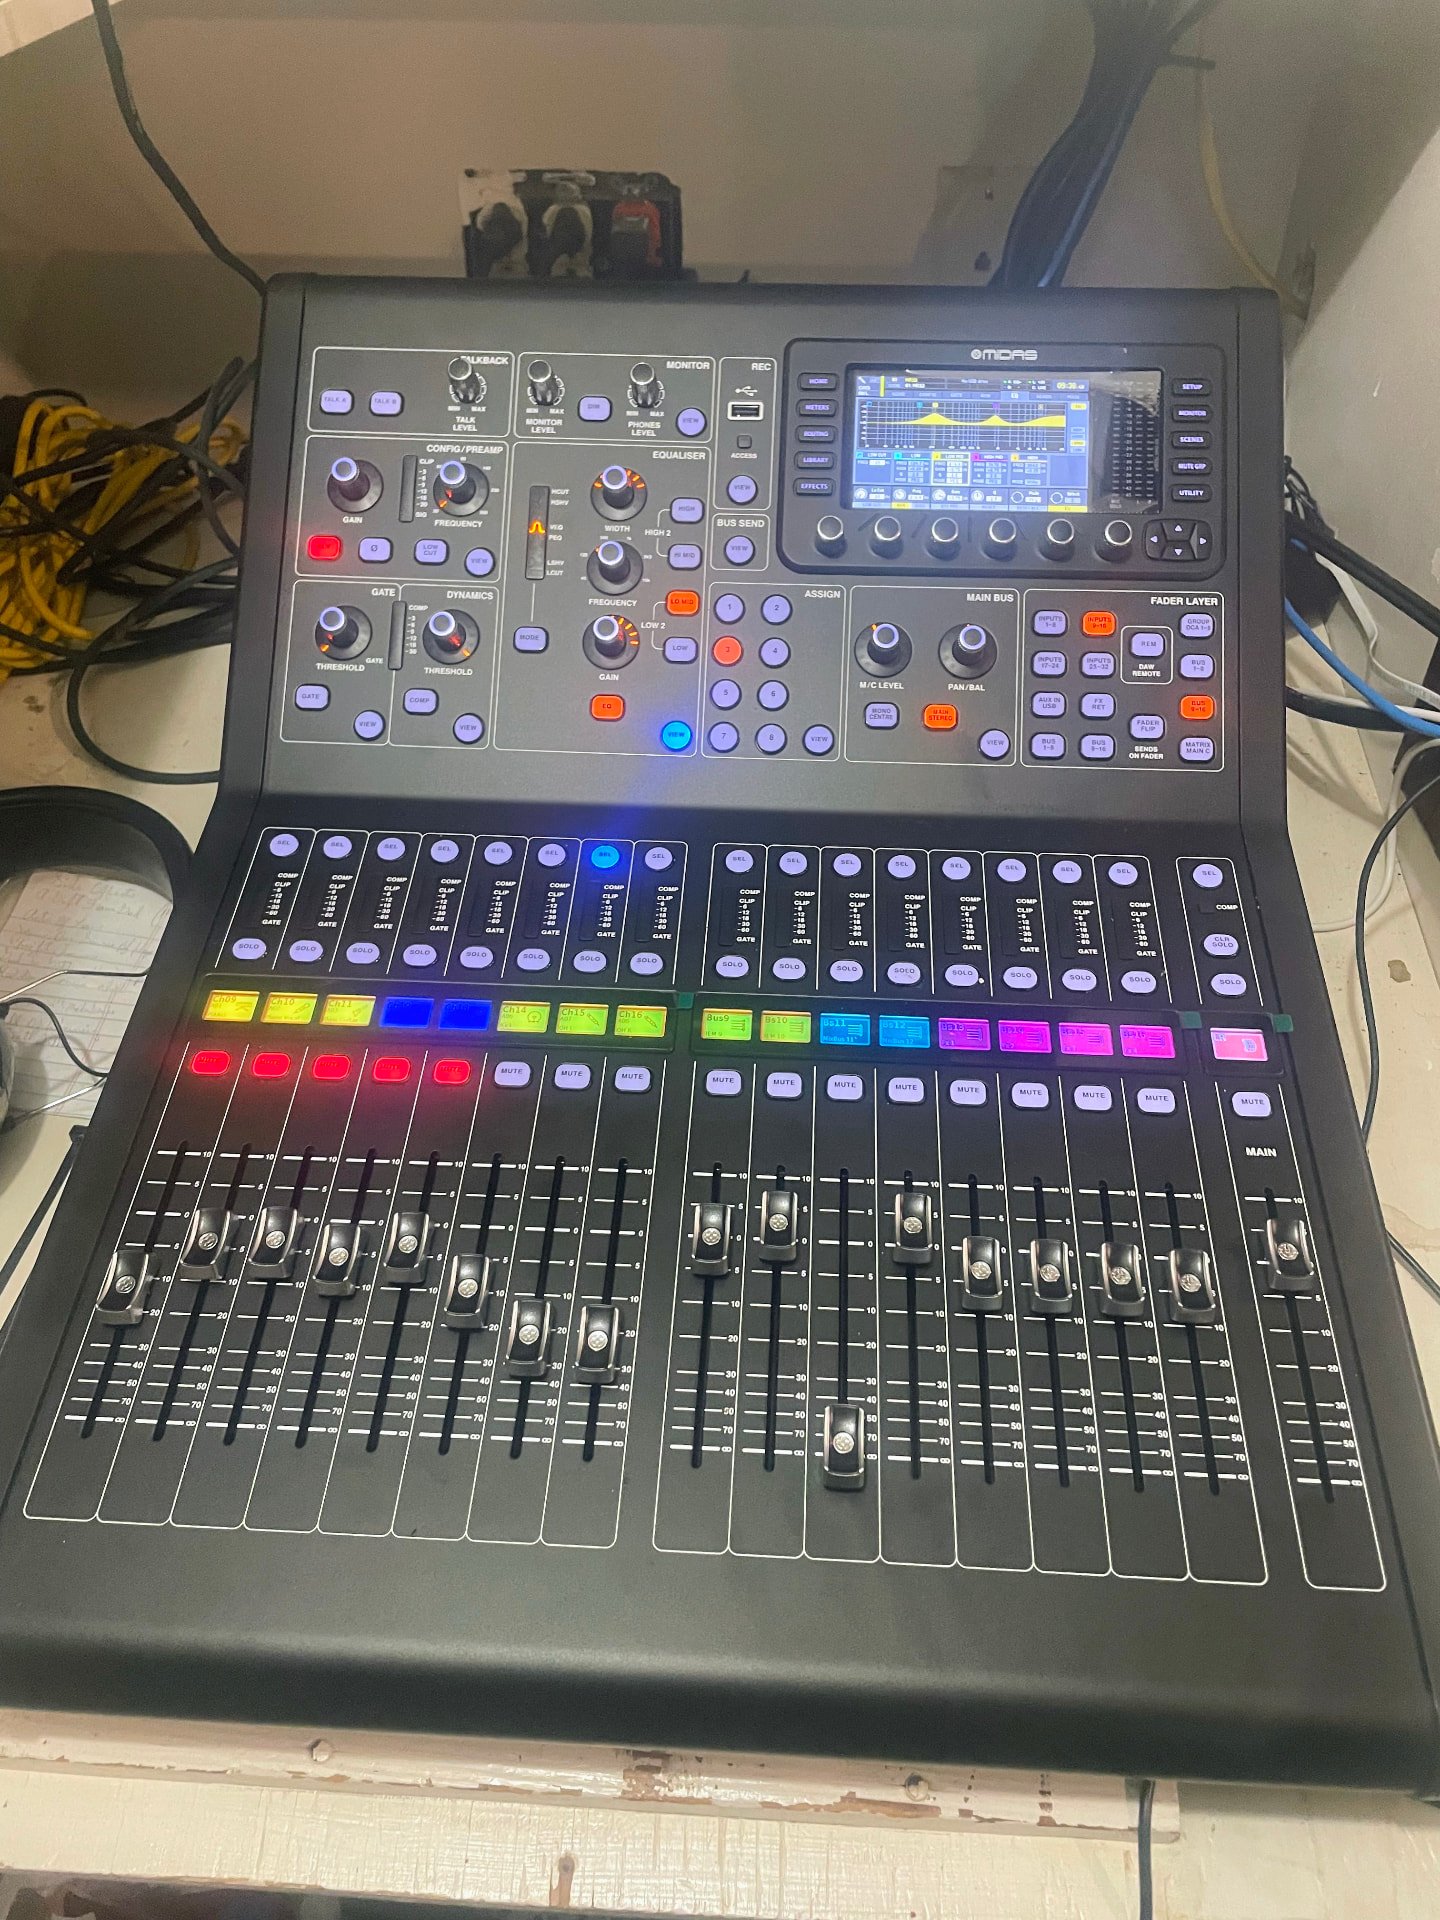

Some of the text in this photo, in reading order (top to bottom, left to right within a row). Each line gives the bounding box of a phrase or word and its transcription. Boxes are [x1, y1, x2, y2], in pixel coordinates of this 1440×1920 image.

[982, 349, 1038, 360] MIDAS
[667, 361, 710, 370] MONITOR
[752, 363, 771, 371] REC
[453, 424, 477, 432] LEVEL
[531, 426, 556, 434] LEVEL
[653, 451, 705, 460] EQUALISER
[435, 520, 482, 528] FREQUENCY
[717, 519, 765, 527] BUS SEND
[447, 591, 493, 600] DYNAMICS
[804, 590, 840, 598] ASSIGN
[967, 594, 1014, 602] MAIN BUS
[589, 599, 637, 607] FREQUENCY
[1151, 597, 1218, 605] FADER LAYER
[316, 663, 365, 671] THRESHOLD
[424, 667, 473, 675] THRESHOLD
[878, 682, 904, 690] LEVEL
[948, 684, 985, 692] PAN/BAL
[503, 1006, 526, 1014] Ch14
[562, 1008, 584, 1016] Ch15
[1246, 1147, 1276, 1157] MAIN
